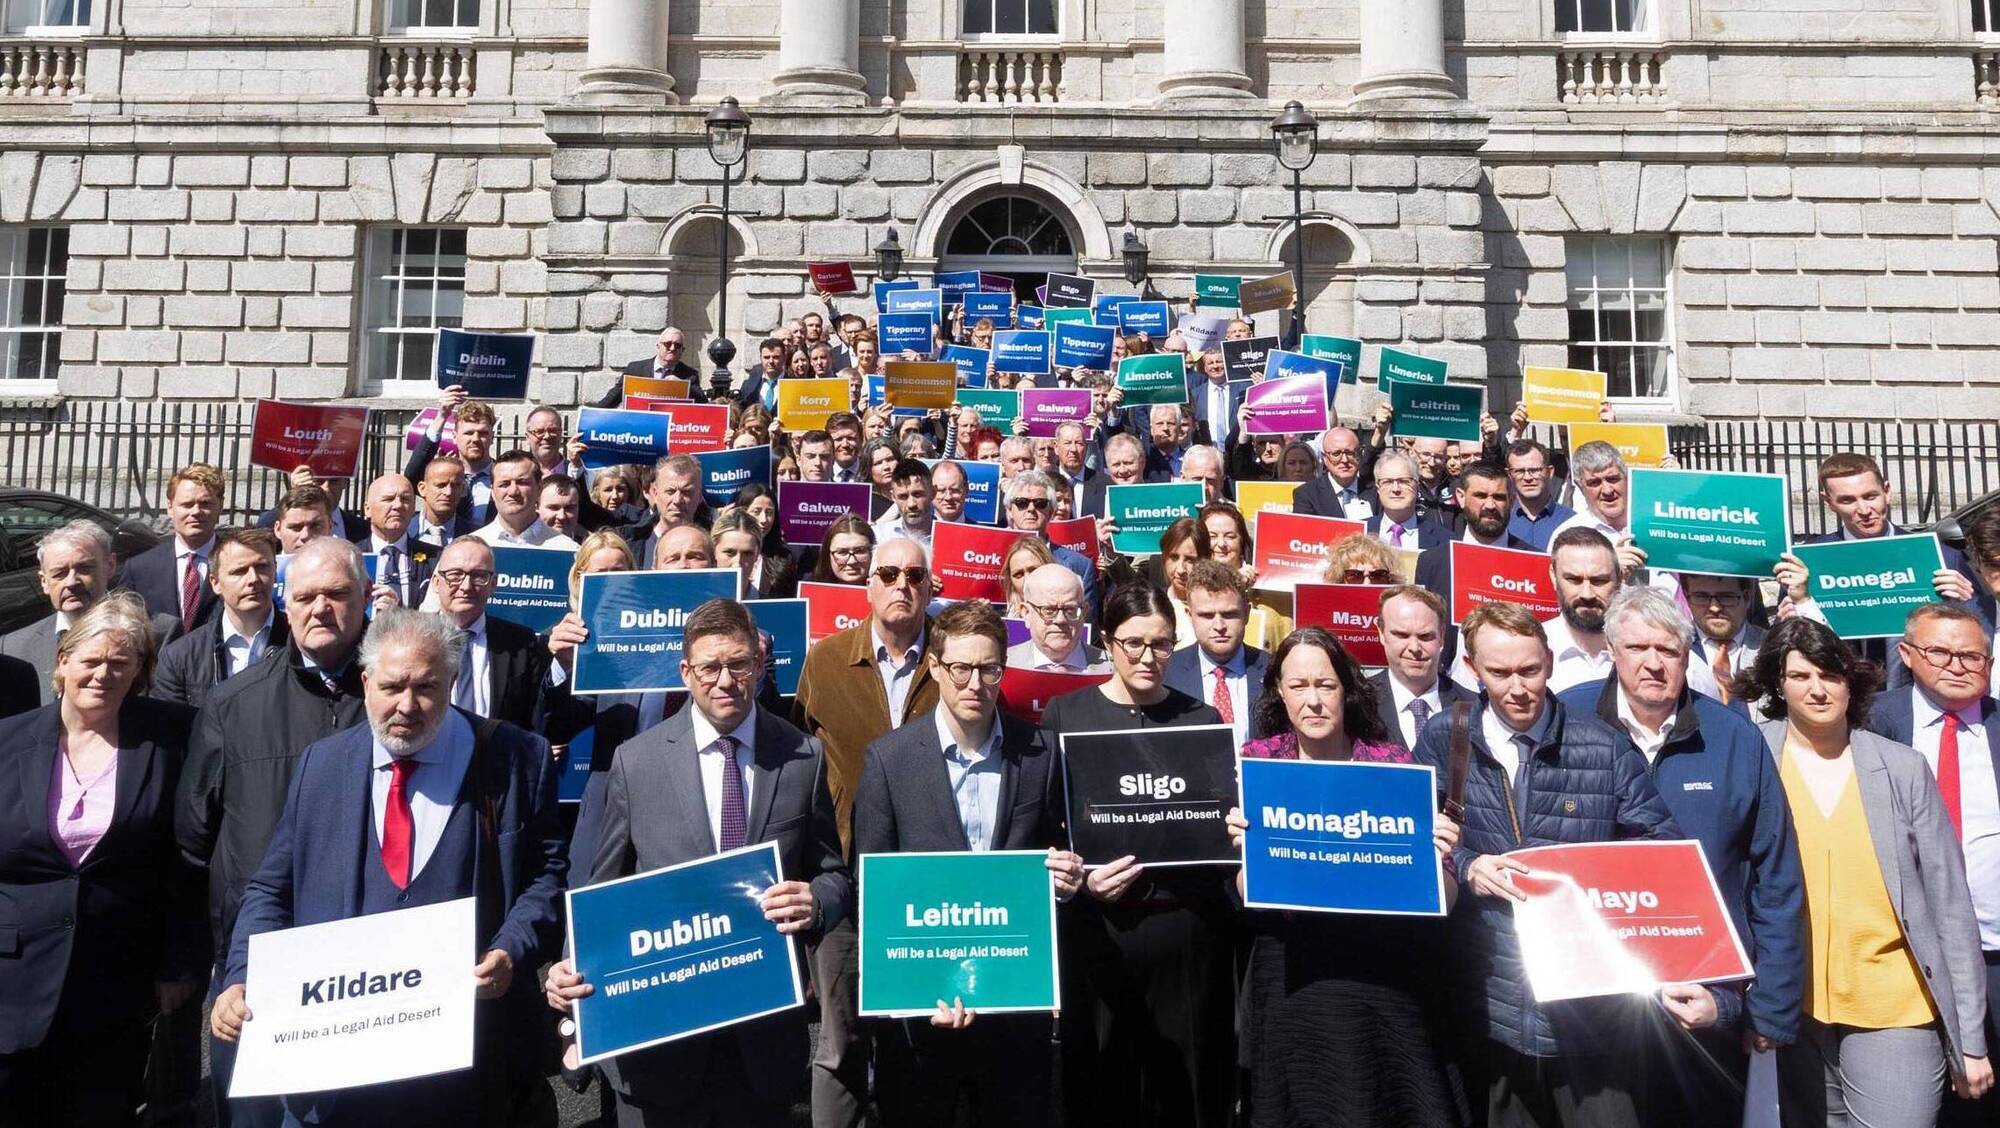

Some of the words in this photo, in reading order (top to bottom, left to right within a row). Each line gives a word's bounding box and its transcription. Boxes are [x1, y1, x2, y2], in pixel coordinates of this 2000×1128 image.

[1061, 284, 1079, 294] Sligo
[886, 326, 926, 334] Tipperary
[998, 344, 1042, 352] Waterford
[1062, 336, 1105, 350] Tipperary
[460, 353, 506, 366] Dublin
[952, 357, 973, 366] Laois
[1241, 351, 1264, 360] Sligo
[1312, 349, 1352, 361] Limerick
[1125, 370, 1173, 381] Limerick
[1388, 364, 1434, 382] Limerick
[800, 396, 831, 406] Kerry
[1411, 400, 1460, 411] Leitrim
[974, 404, 1002, 413] Offaly
[1037, 404, 1077, 415] Galway
[284, 426, 332, 440] Louth
[670, 422, 710, 432] Carlow
[590, 430, 653, 445] Longford
[711, 469, 750, 482] Dublin
[798, 502, 850, 515] Galway
[1125, 505, 1189, 519] Limerick
[1654, 501, 1760, 525] Limerick
[1649, 529, 1666, 538] Will
[1667, 530, 1679, 539] be
[1688, 532, 1714, 543] Legal
[1716, 535, 1731, 544] Aid
[1733, 537, 1766, 547] Desert
[1289, 540, 1329, 555] Cork
[963, 550, 1002, 565] Cork
[497, 573, 554, 589] Dublin
[1491, 575, 1537, 594] Cork
[1819, 567, 1916, 589] Donegal
[1468, 593, 1482, 601] Will
[1816, 600, 1834, 609] Will
[1836, 599, 1846, 608] be
[1856, 598, 1880, 607] Legal
[1882, 596, 1897, 604] Aid
[1899, 595, 1930, 603] Desert
[835, 615, 865, 629] Co
[597, 644, 615, 652] Will
[617, 643, 629, 652] be
[639, 642, 664, 653] Legal
[666, 642, 683, 650] Aid
[1119, 773, 1186, 800] Sligo
[1091, 813, 1110, 824] Will
[1112, 813, 1125, 823] be
[1136, 811, 1164, 824] Legal
[1165, 810, 1183, 820] Aid
[1185, 809, 1220, 820] Desert
[1262, 806, 1415, 839] Monaghan
[1269, 846, 1290, 858] Will
[1293, 849, 1307, 860] be
[1309, 852, 1316, 860] a
[1319, 850, 1350, 864] Legal
[1352, 851, 1371, 863] Aid
[1374, 853, 1413, 865] Desert
[906, 902, 1008, 927] Leitrim
[630, 913, 732, 957] Dublin
[1640, 926, 1659, 936] Aid
[1661, 925, 1704, 936] Desert
[886, 947, 908, 959] Will
[911, 947, 924, 958] be
[926, 950, 933, 958] a
[936, 946, 967, 960] Legal
[969, 946, 988, 957] Aid
[991, 945, 1029, 957] Desert
[605, 980, 630, 997] Will
[632, 976, 648, 990] be
[651, 976, 659, 986] a
[661, 964, 696, 983] Legal
[698, 958, 719, 975] Aid
[722, 948, 763, 969] Desert
[301, 968, 422, 1006] Kildare
[274, 1032, 299, 1044] Will
[302, 1028, 318, 1040] be
[322, 1028, 329, 1036] a
[334, 1019, 370, 1036] Legal
[373, 1014, 394, 1026] Aid
[399, 1006, 441, 1023] Desert
